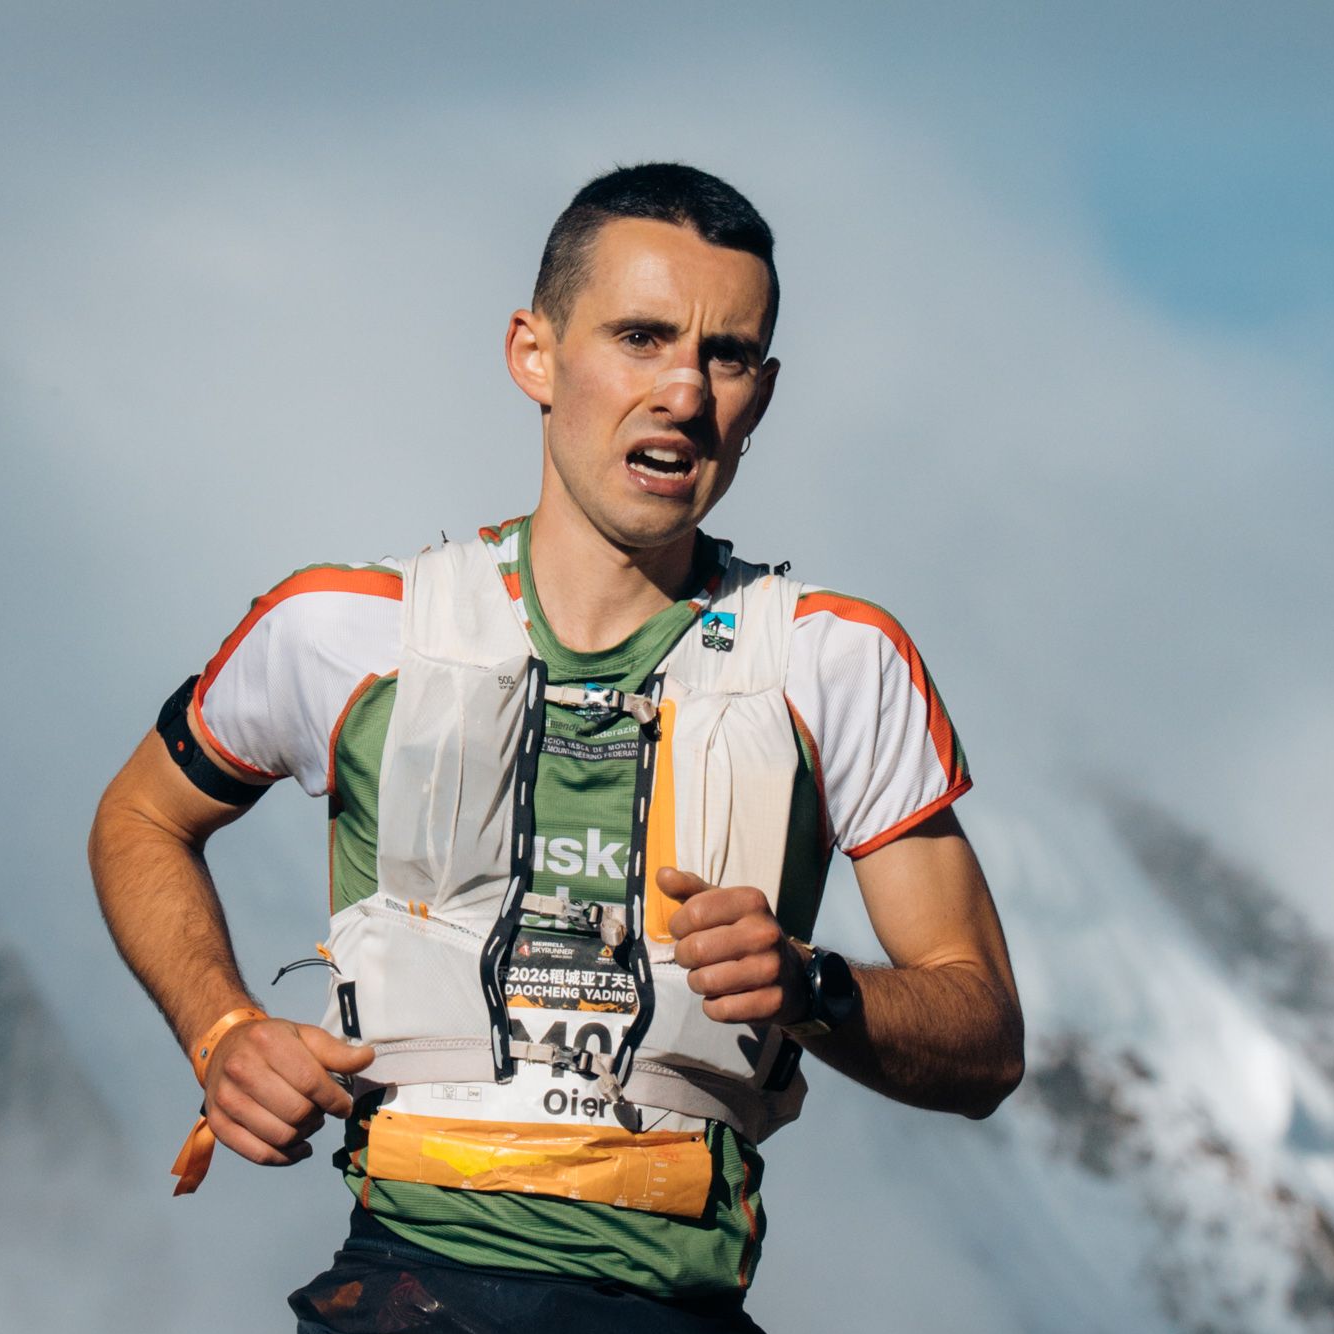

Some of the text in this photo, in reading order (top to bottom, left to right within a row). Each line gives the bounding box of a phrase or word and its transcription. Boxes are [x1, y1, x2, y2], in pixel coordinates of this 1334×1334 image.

[531, 946, 573, 955] SKYRUNNER
[505, 984, 635, 1004] DAOCHENG YADING
[543, 1088, 612, 1118] Oier
